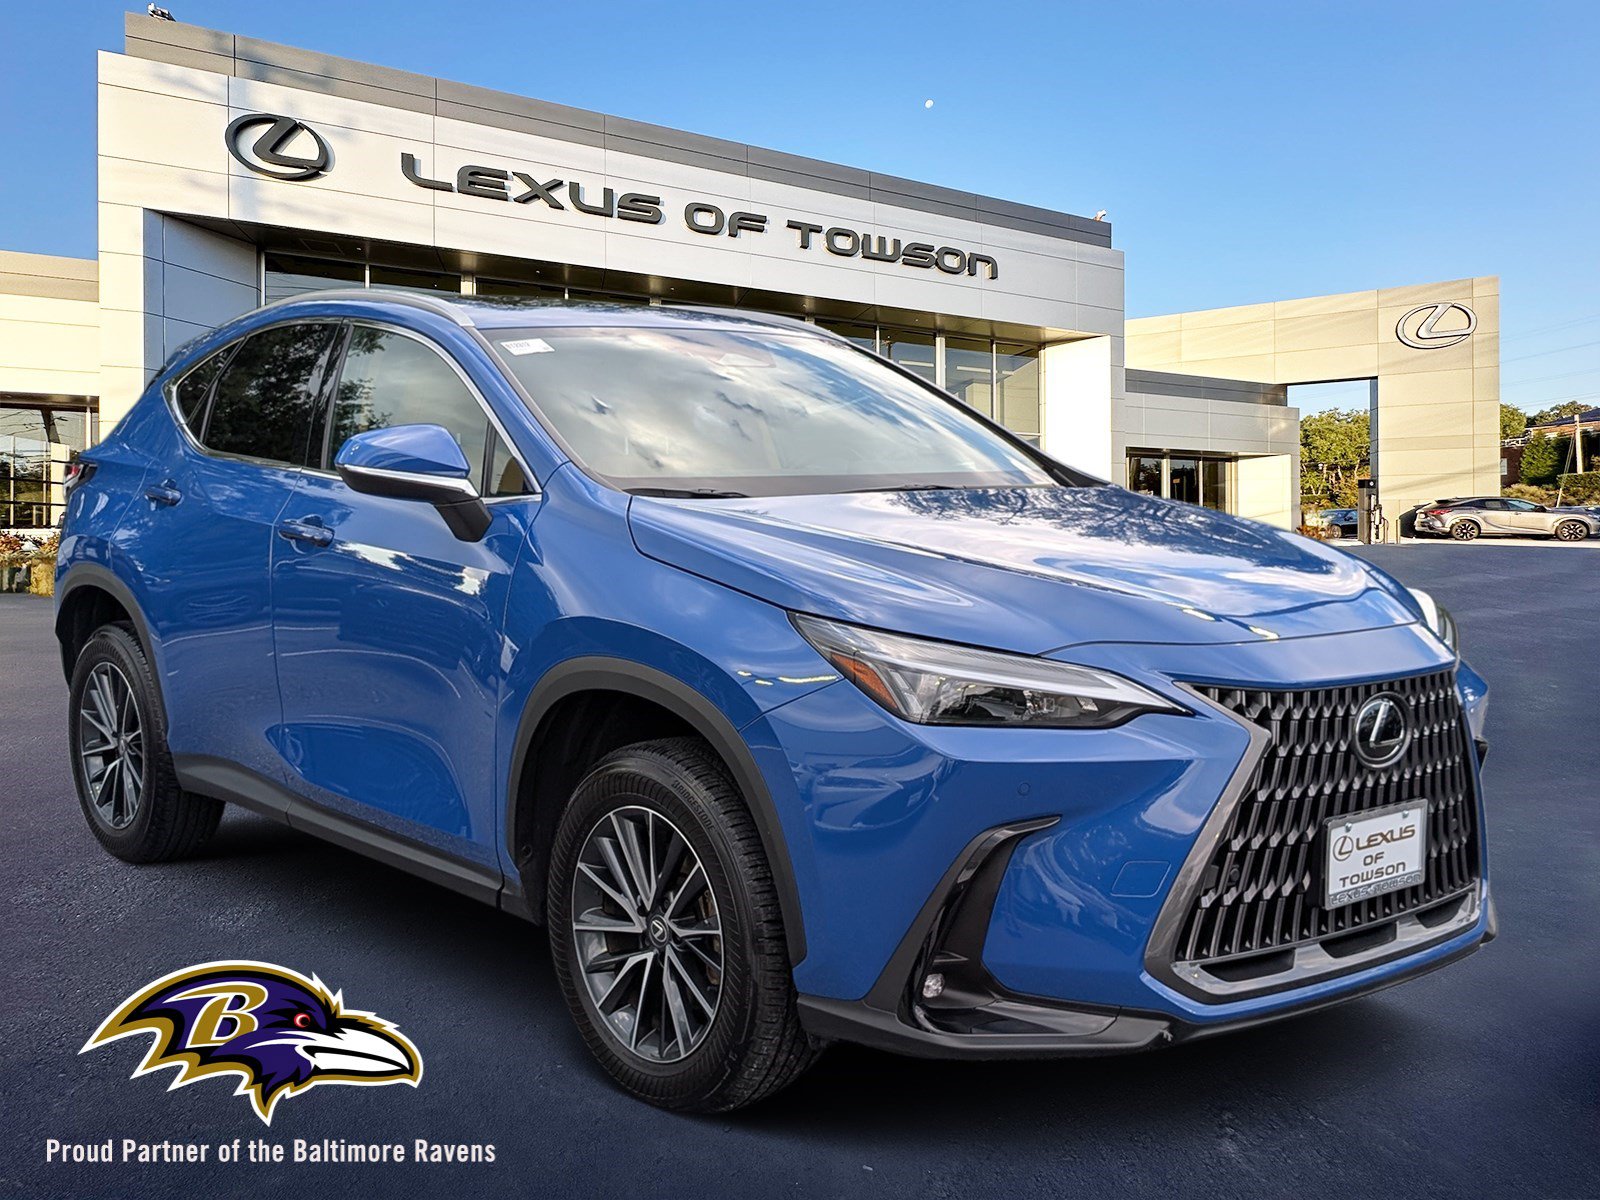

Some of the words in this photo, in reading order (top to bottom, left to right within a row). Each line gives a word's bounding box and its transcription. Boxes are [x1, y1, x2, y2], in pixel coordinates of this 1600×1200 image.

[401, 152, 664, 226] LEXUS
[684, 202, 768, 238] OF
[786, 219, 999, 281] TOWSON
[671, 780, 716, 832] BRIDGESTONE
[1355, 824, 1416, 850] LEXUS
[1363, 851, 1385, 867] OF
[1339, 861, 1406, 888] TOWSON
